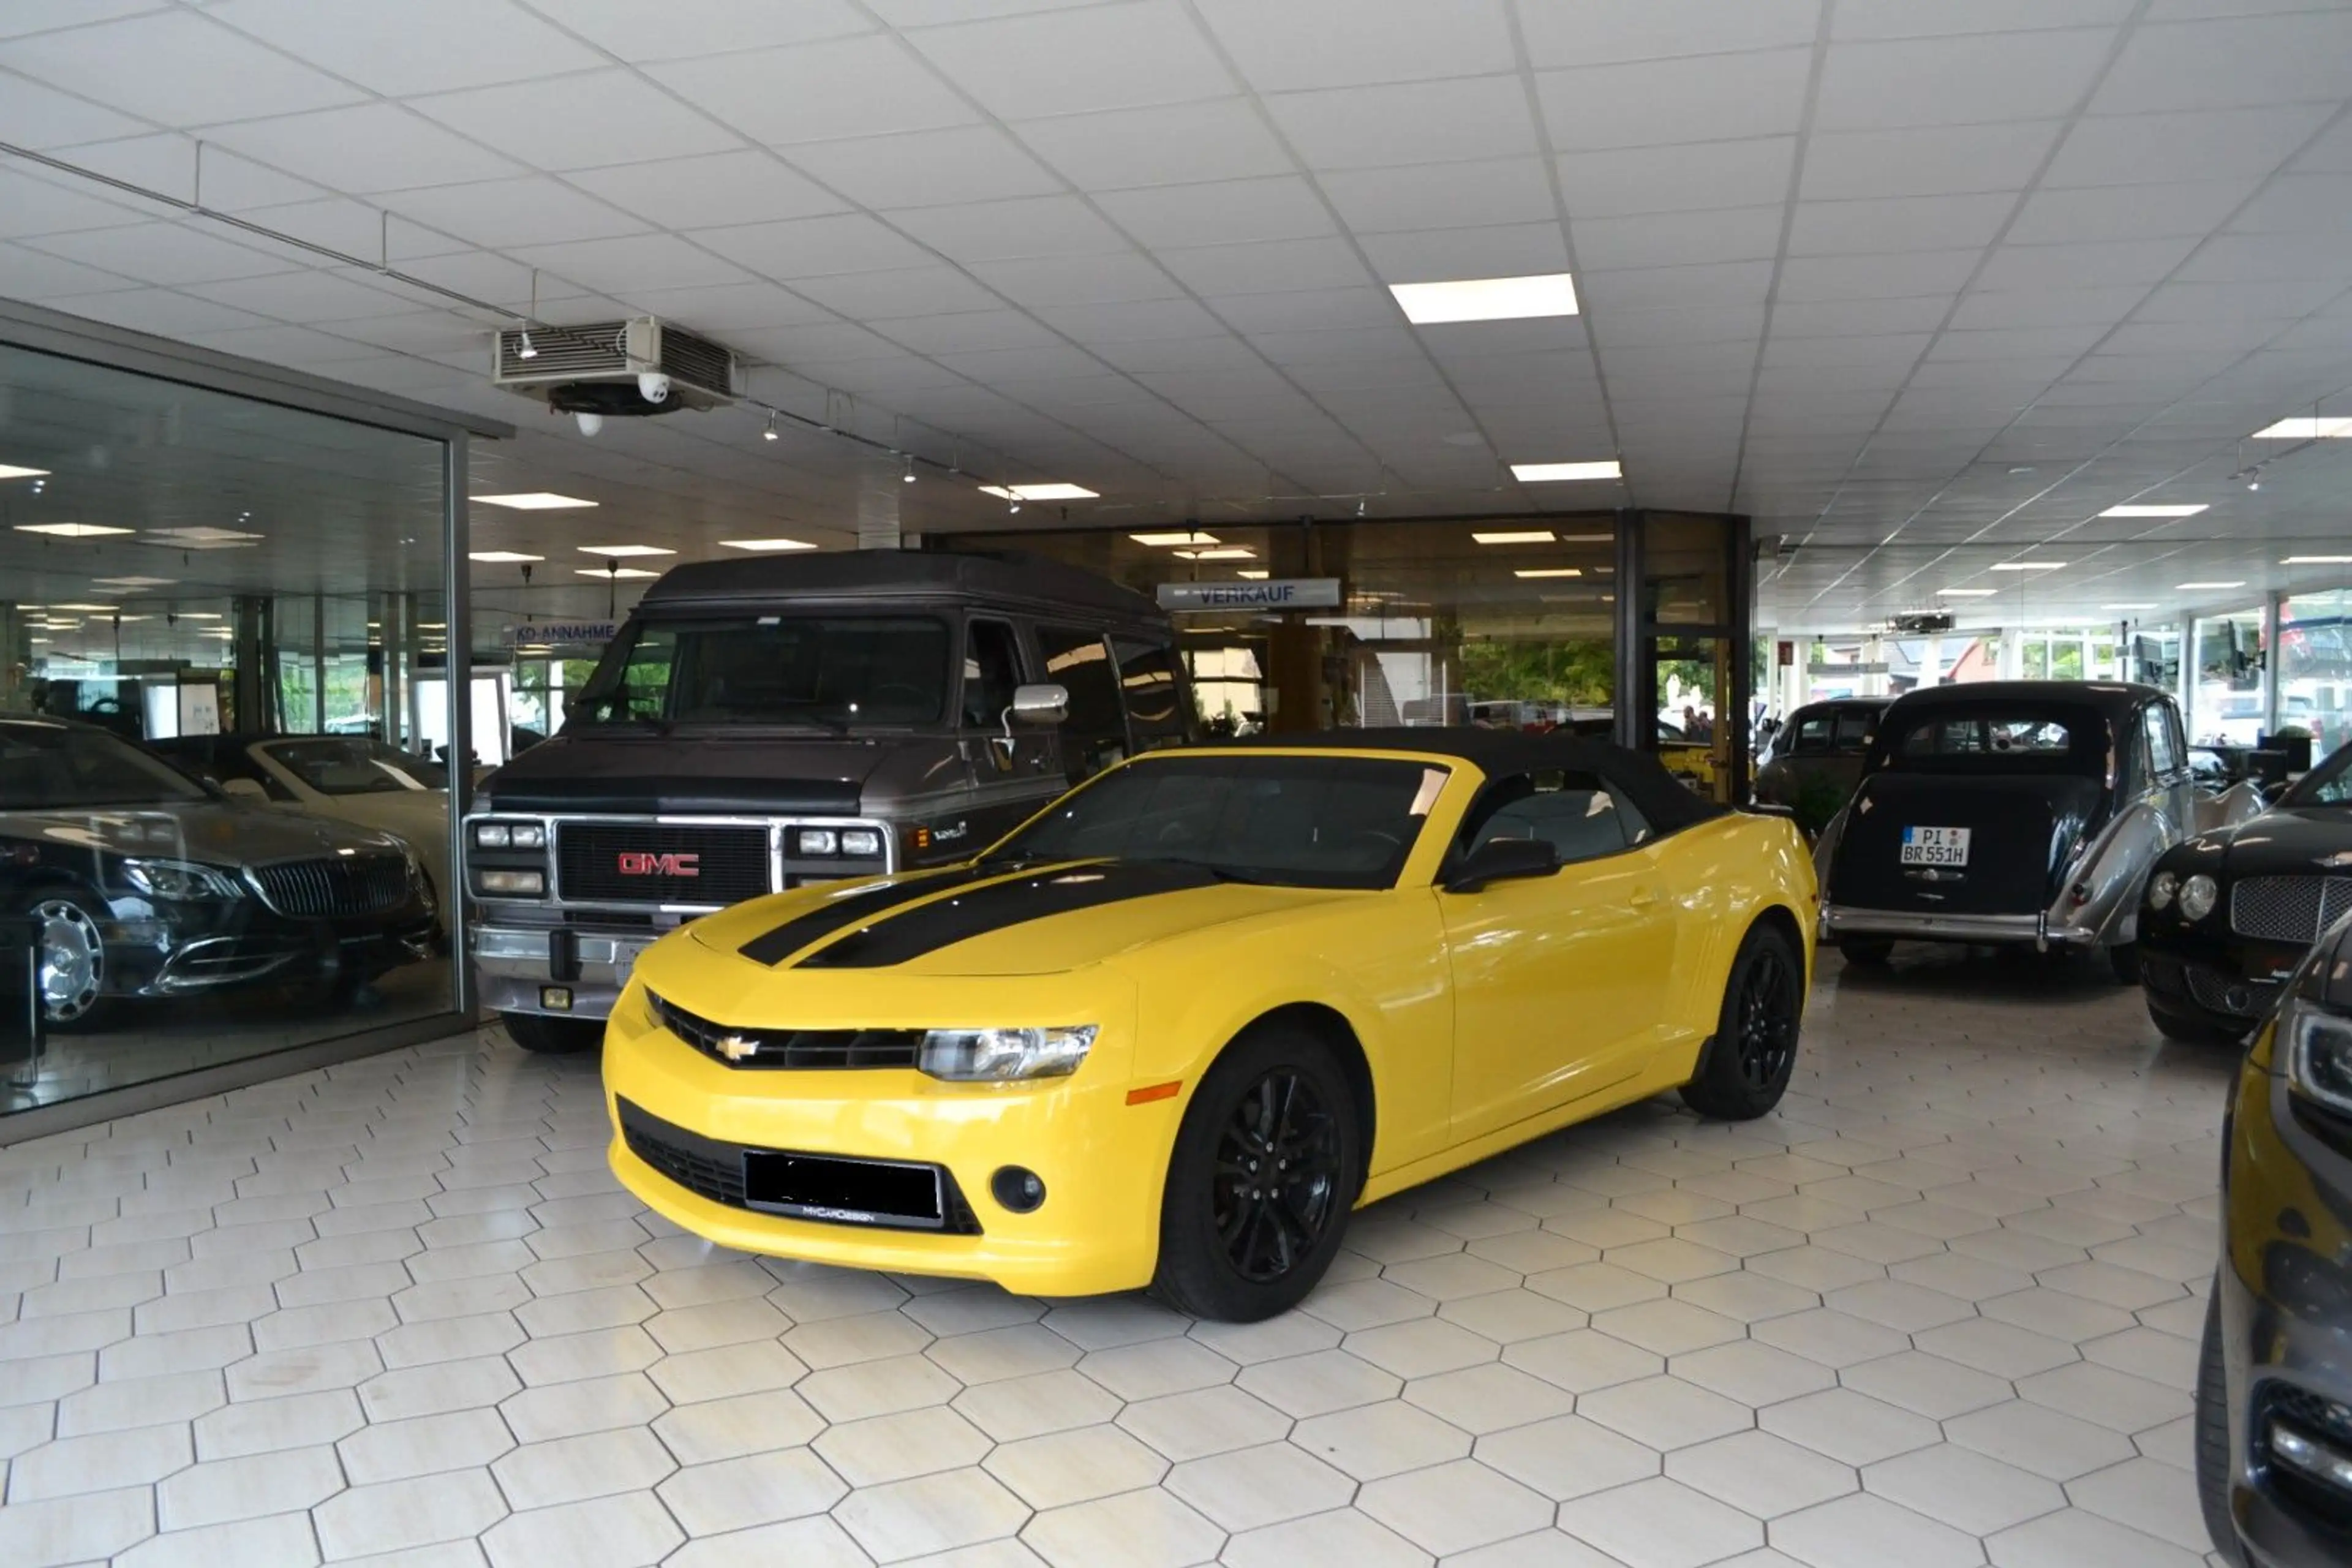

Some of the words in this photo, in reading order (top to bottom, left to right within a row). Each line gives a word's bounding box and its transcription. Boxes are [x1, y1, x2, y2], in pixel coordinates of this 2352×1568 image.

[1199, 586, 1295, 603] VERKAUF
[517, 624, 614, 641] KD-ANNAHME
[1923, 829, 1942, 844] PI
[1904, 846, 1923, 861] BR
[619, 853, 699, 876] GMC
